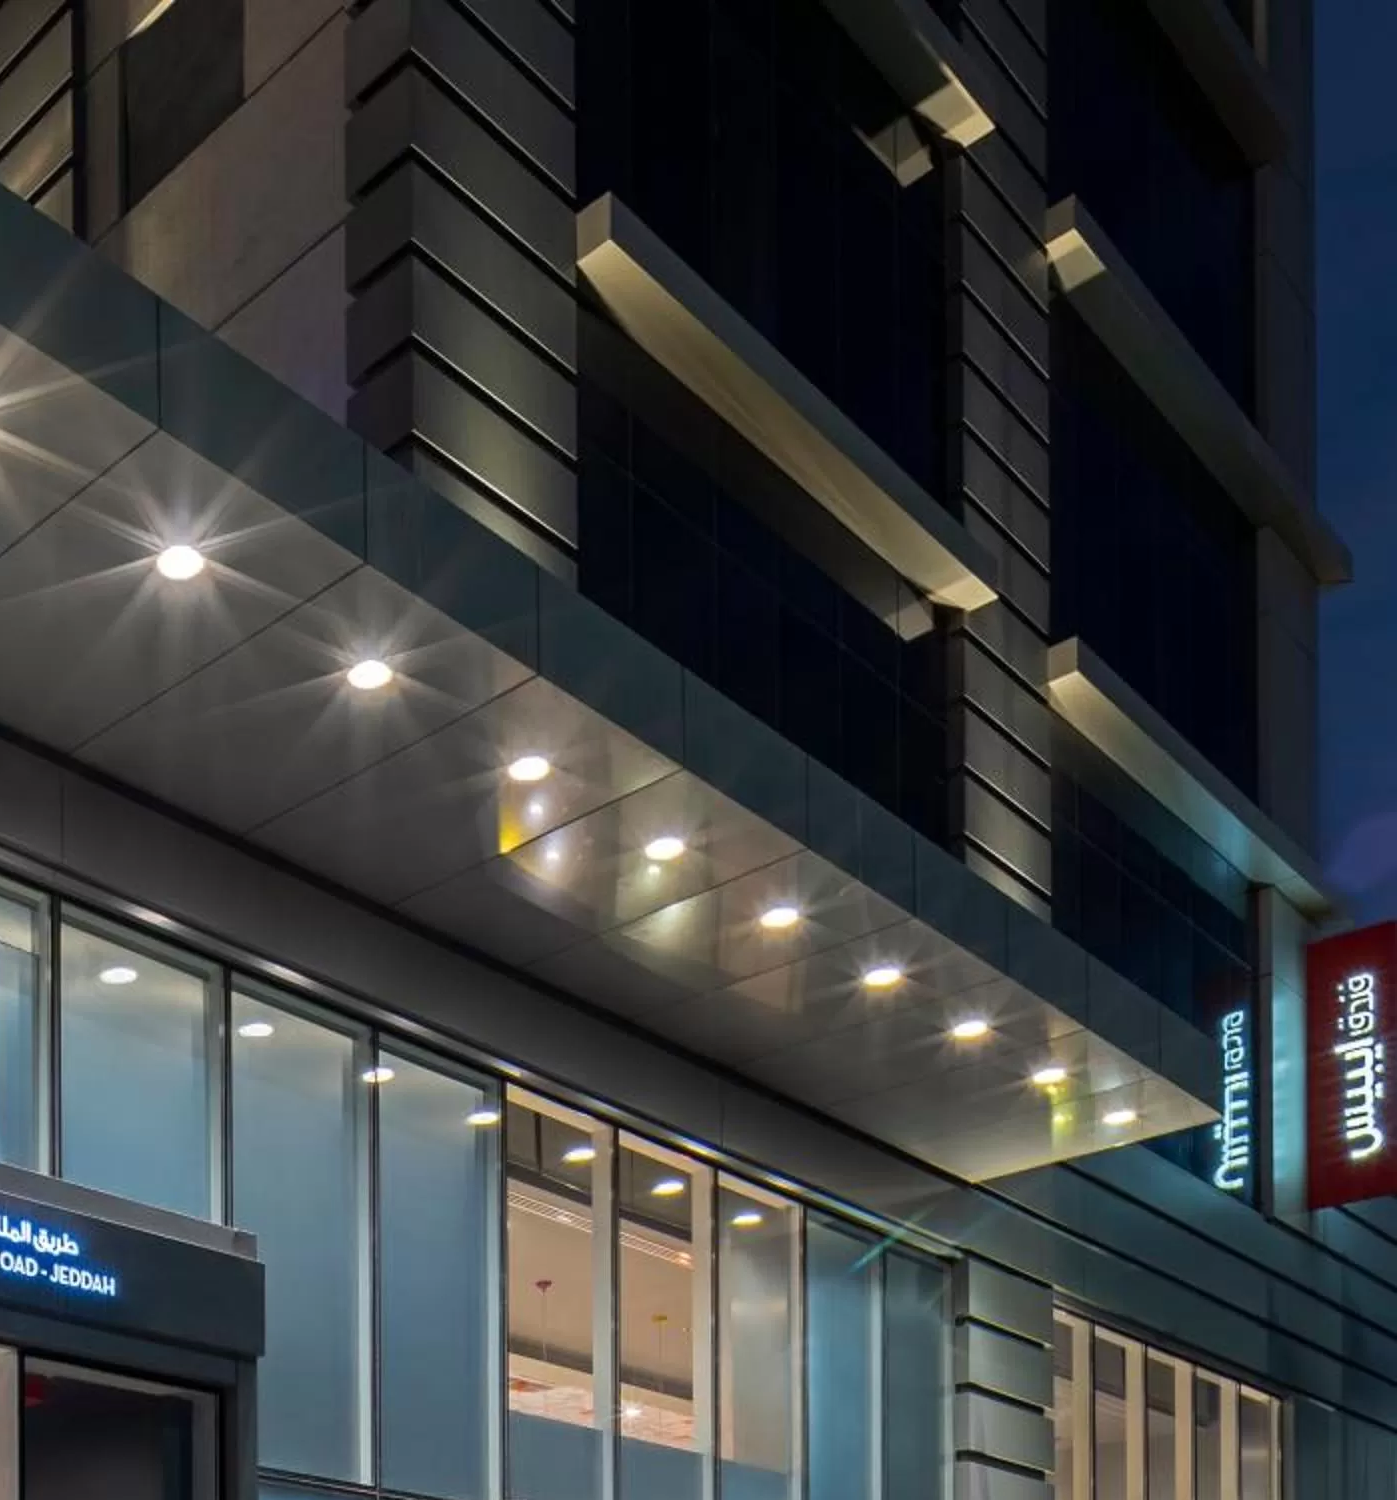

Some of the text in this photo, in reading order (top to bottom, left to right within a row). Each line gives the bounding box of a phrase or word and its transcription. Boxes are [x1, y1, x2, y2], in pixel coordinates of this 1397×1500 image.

[1335, 972, 1375, 1037] فندق
[32, 1226, 80, 1257] طريق
[49, 1265, 116, 1297] JEDDAH
